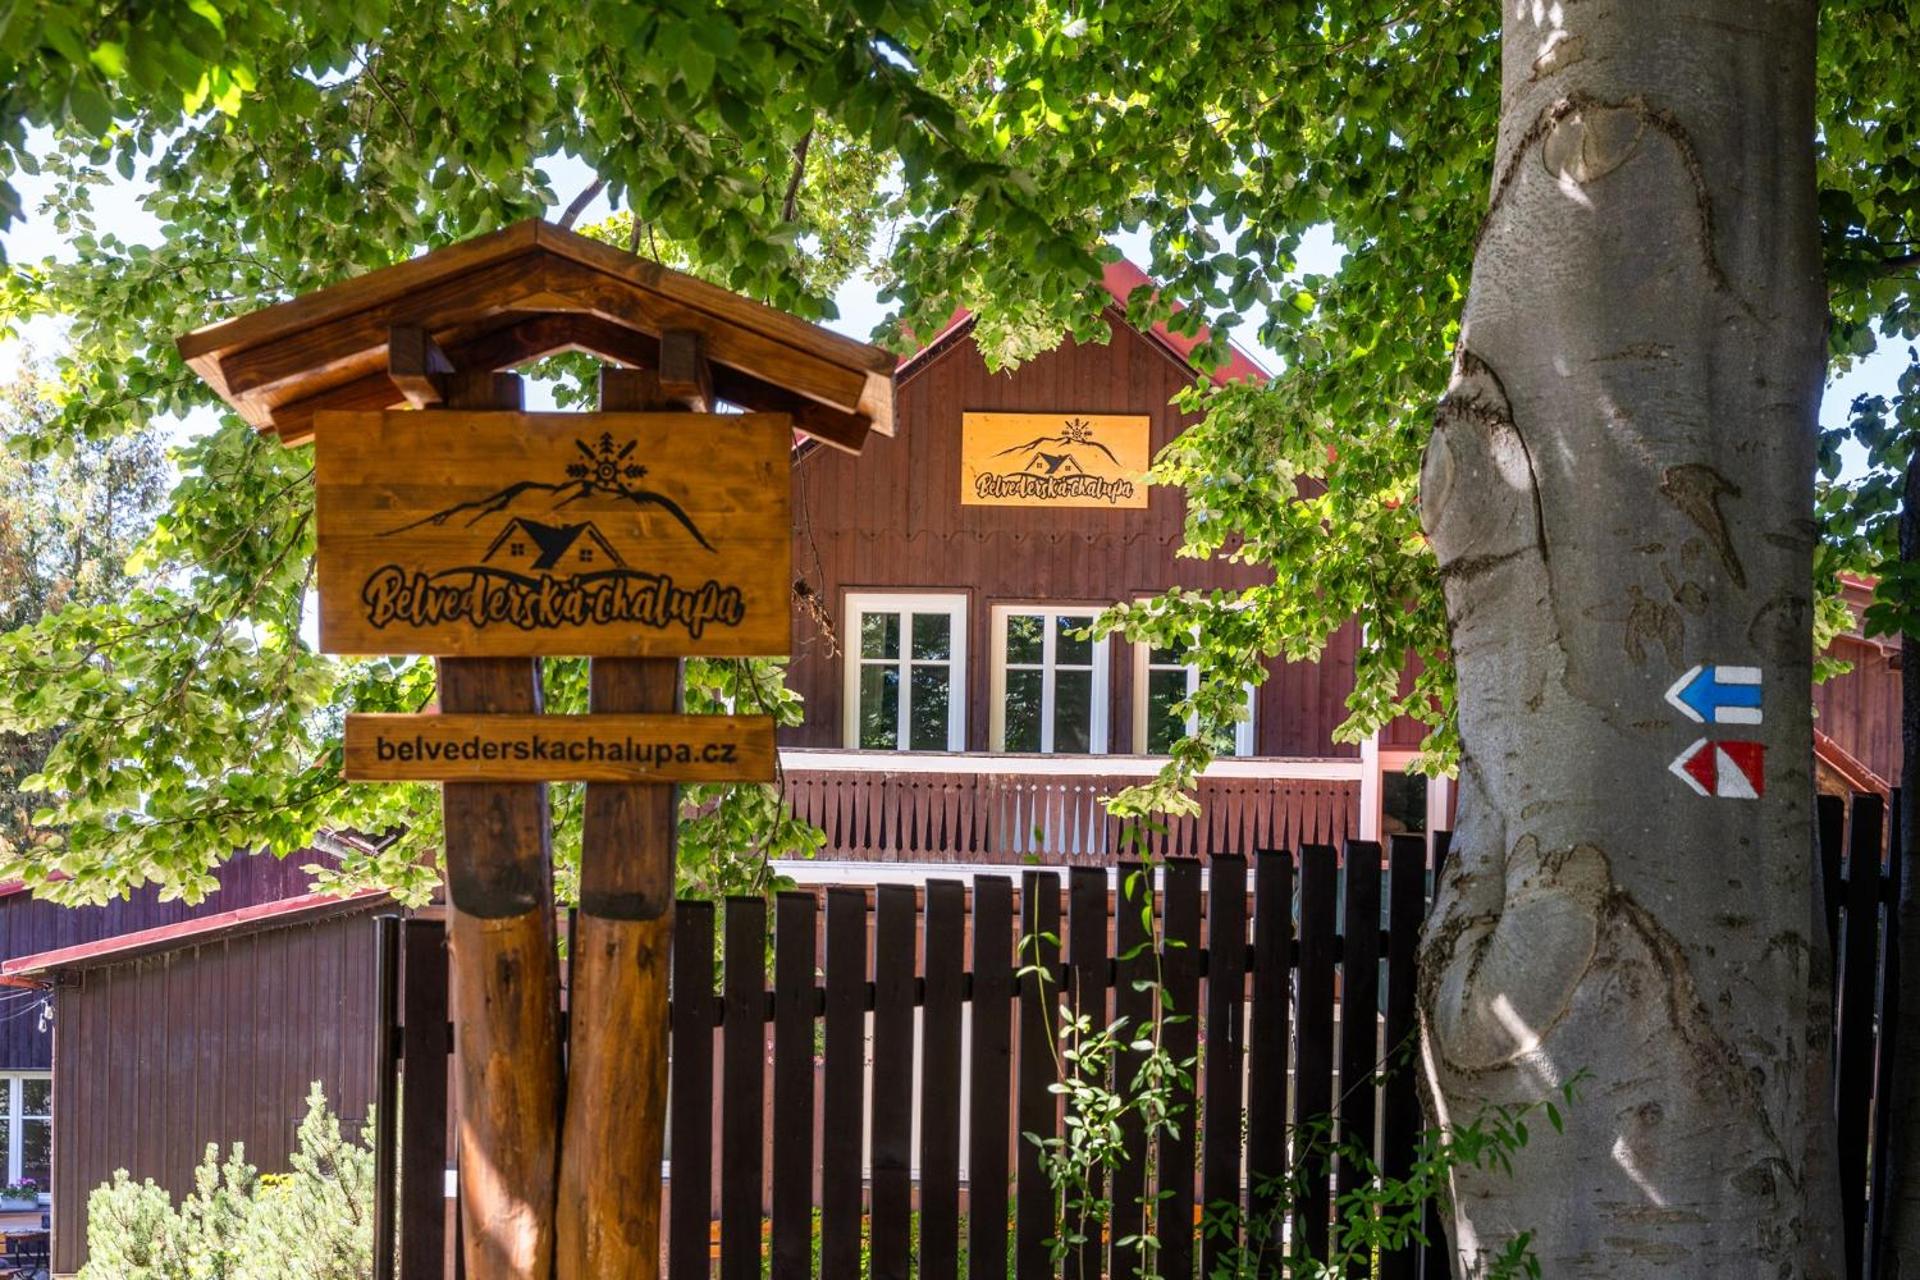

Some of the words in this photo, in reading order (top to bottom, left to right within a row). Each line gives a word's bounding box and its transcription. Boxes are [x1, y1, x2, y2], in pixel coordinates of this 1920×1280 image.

[1070, 476, 1134, 504] chalupa
[591, 573, 746, 640] chalupa
[377, 735, 738, 768] belvederskachalupa.cz
